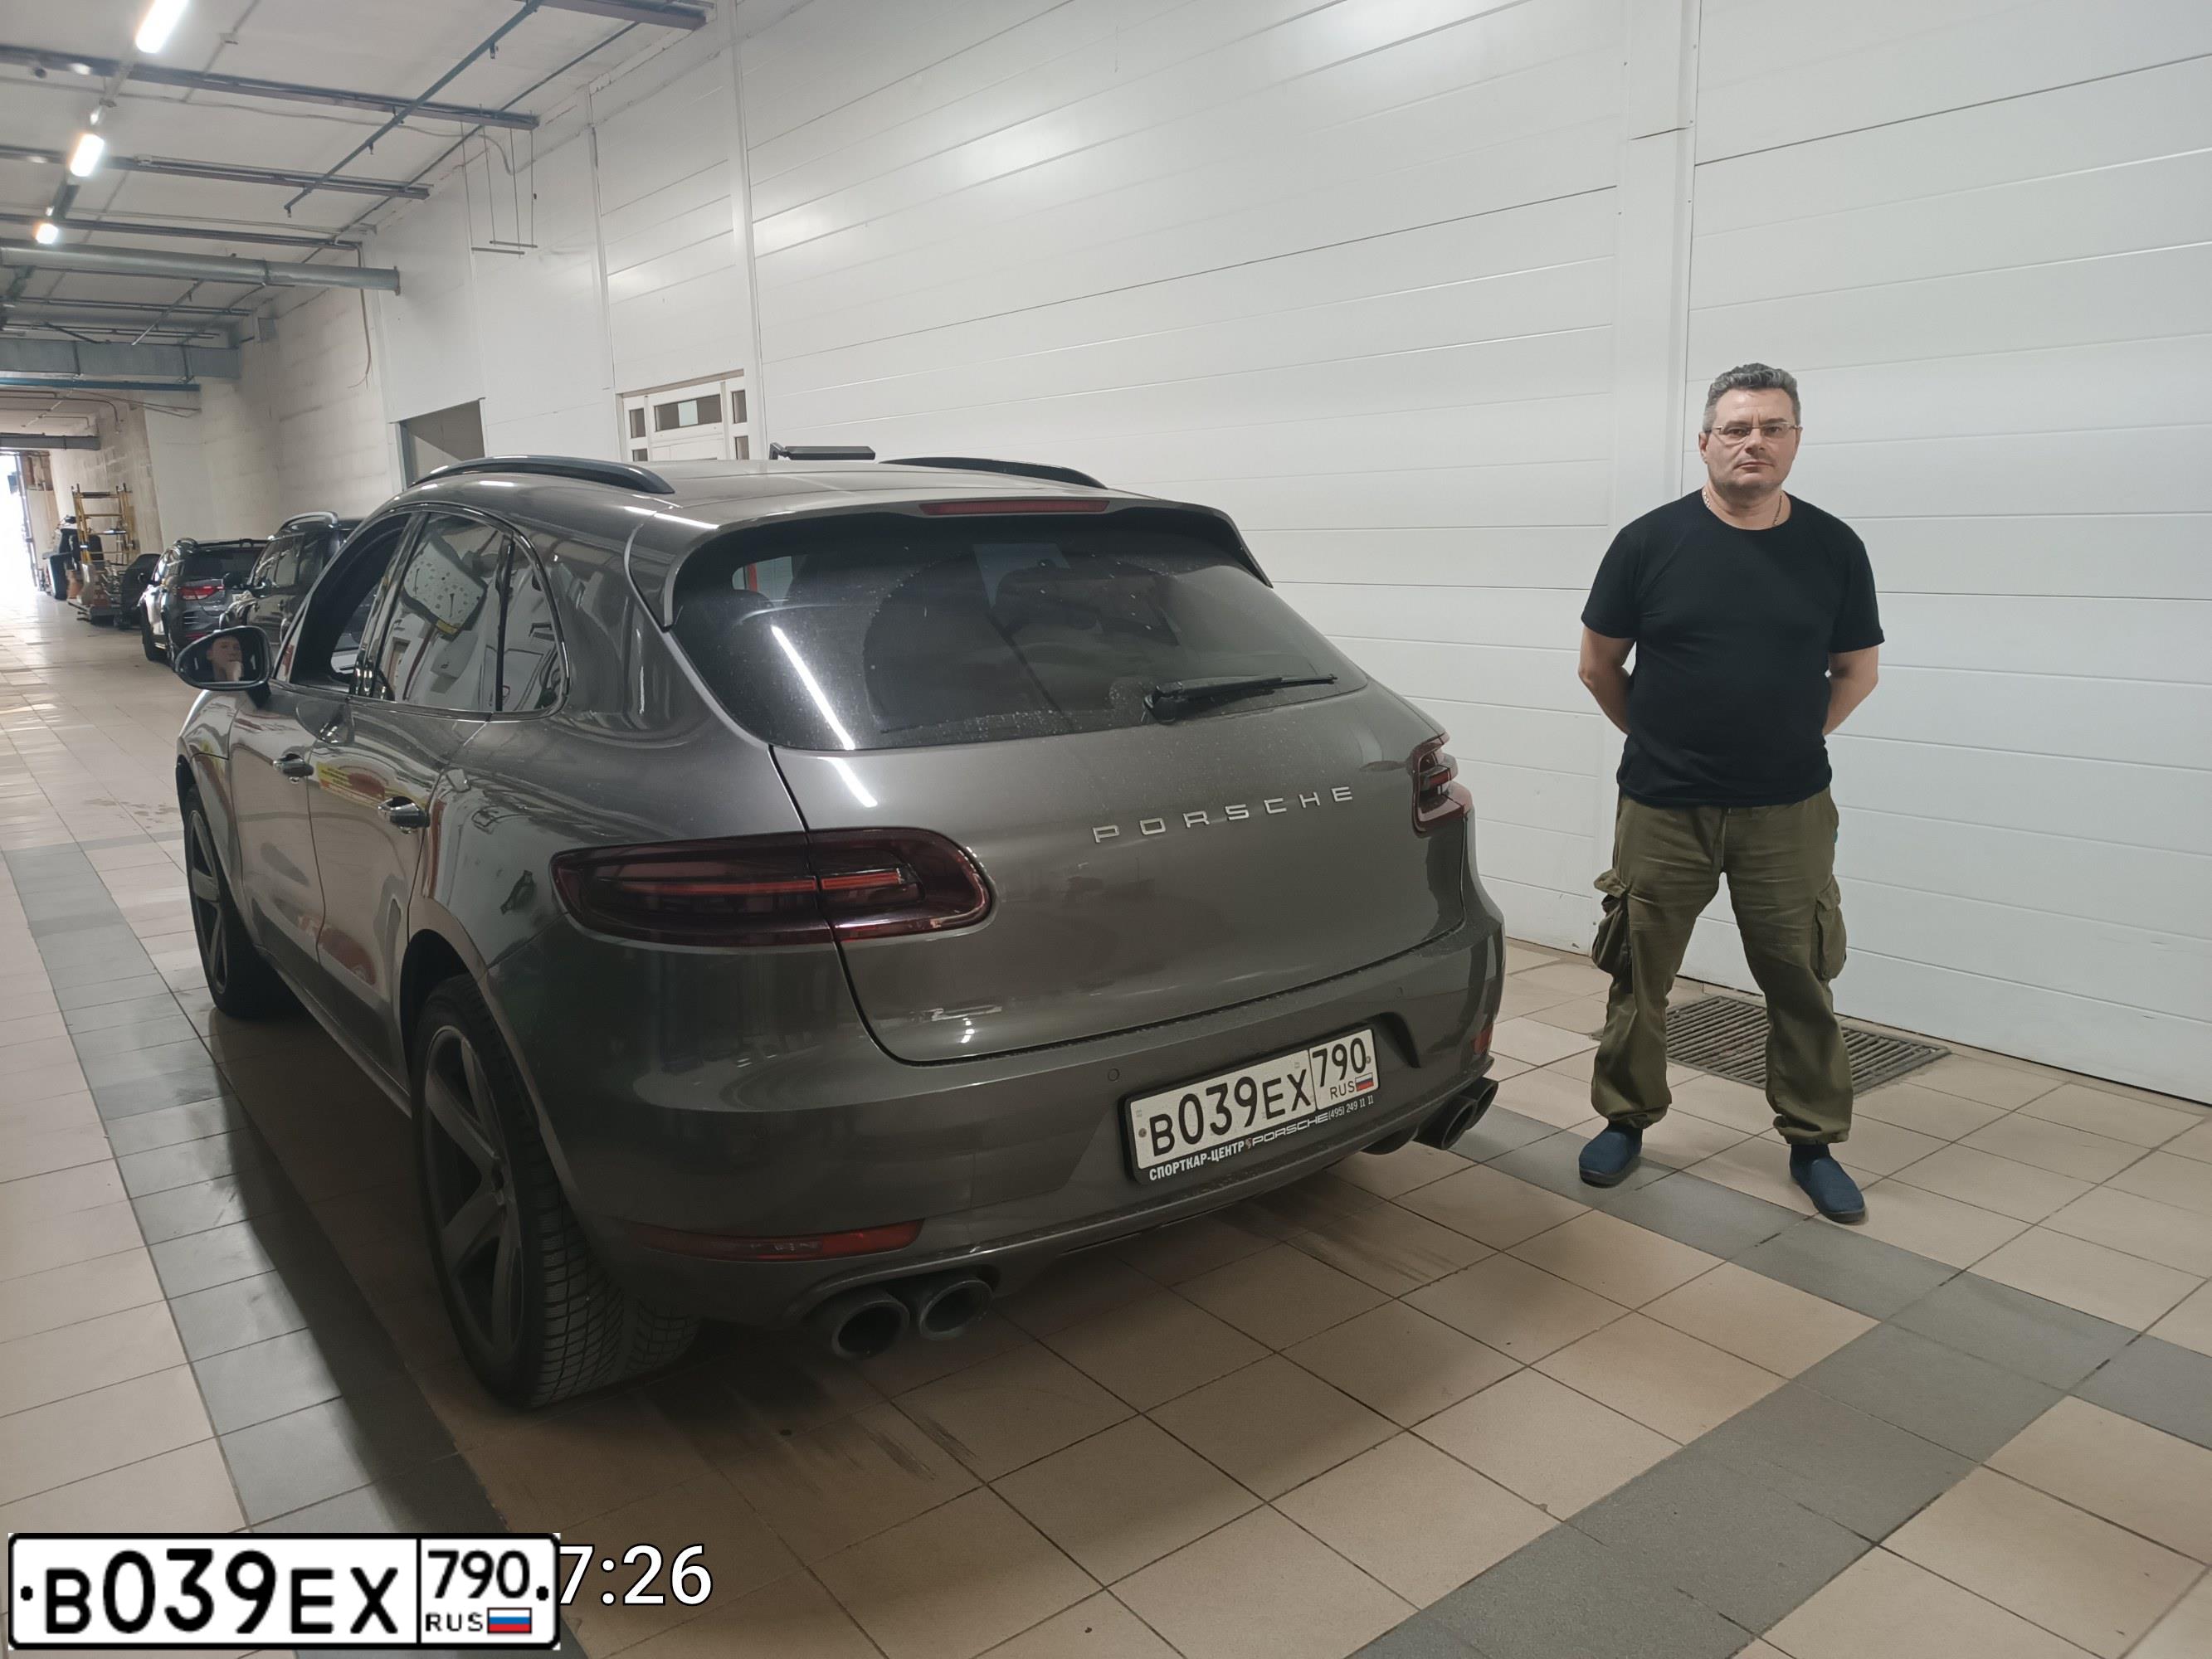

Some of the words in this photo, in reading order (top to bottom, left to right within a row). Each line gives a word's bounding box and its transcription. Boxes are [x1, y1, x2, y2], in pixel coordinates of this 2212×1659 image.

[1092, 786, 1353, 843] PORSCHE
[1312, 1037, 1367, 1088] 790
[1330, 1080, 1356, 1101] RUS
[1149, 1140, 1245, 1181] СПОРТКАР-ЦЕНТР
[1251, 1112, 1328, 1146] PORSCHE
